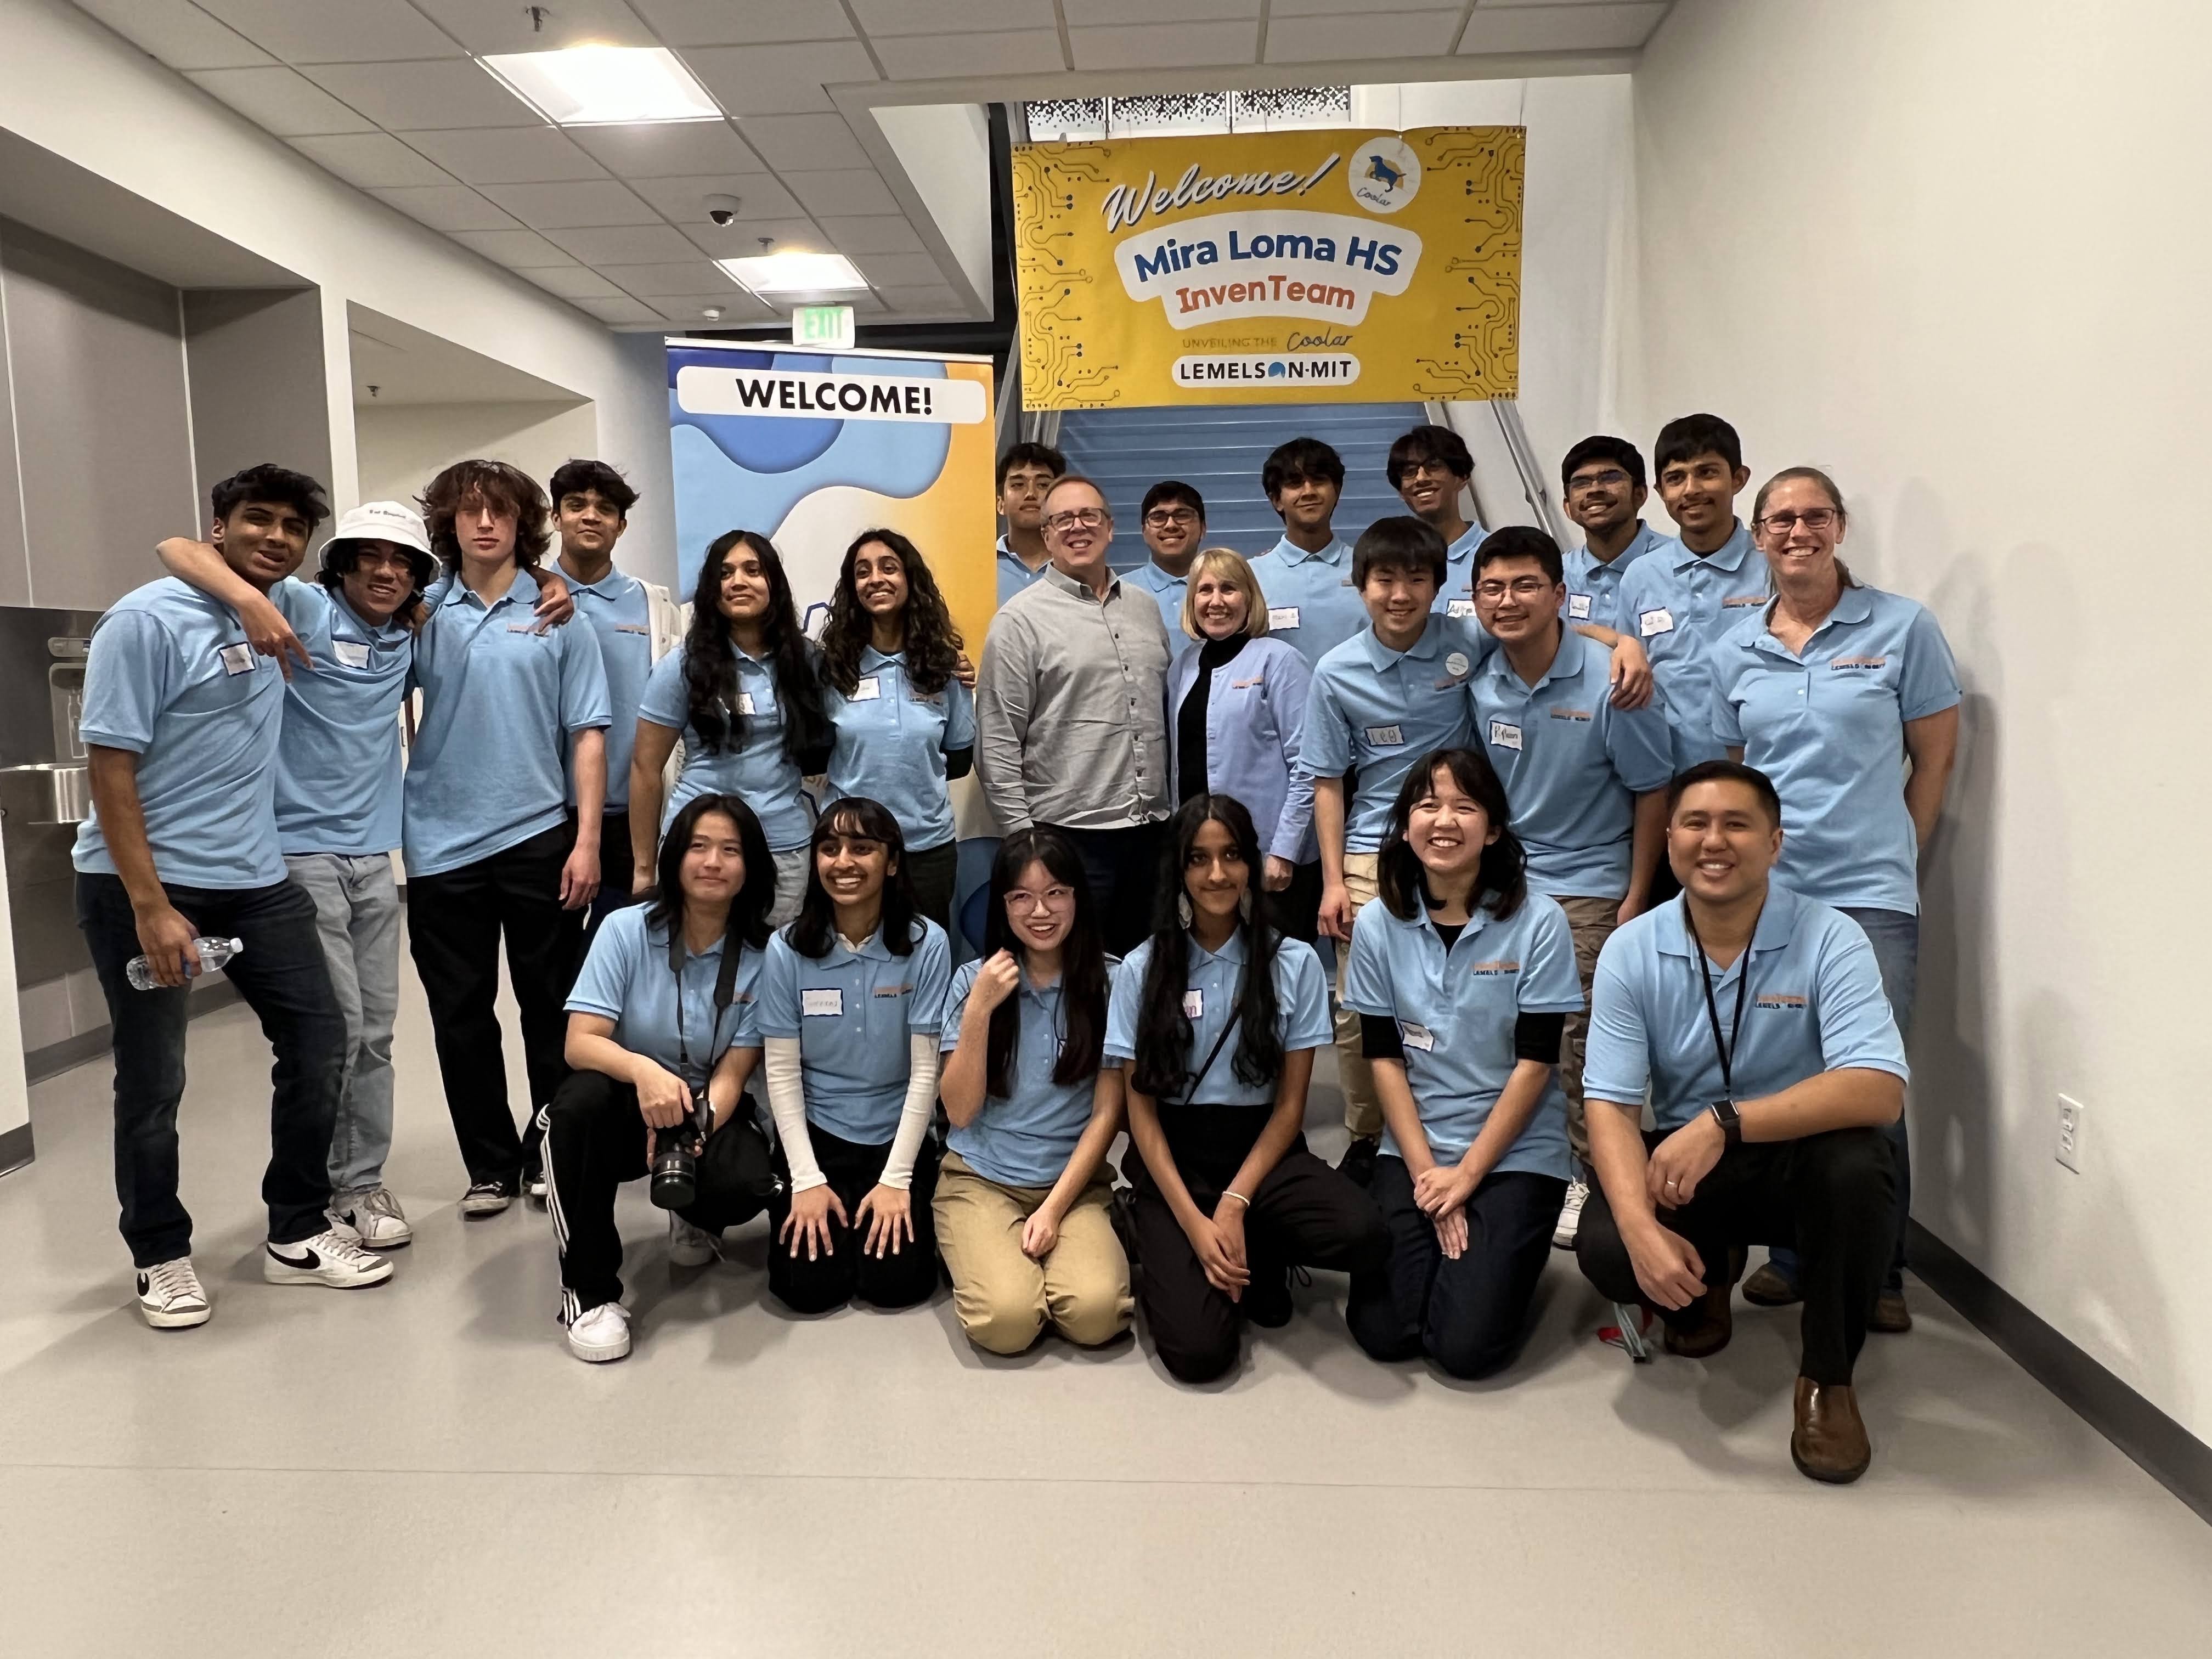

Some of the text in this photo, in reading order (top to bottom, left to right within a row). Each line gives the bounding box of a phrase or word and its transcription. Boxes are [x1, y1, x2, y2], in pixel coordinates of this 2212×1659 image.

[1101, 153, 1340, 233] Welcome!
[1134, 230, 1402, 282] Mira Loma HS
[1176, 275, 1356, 313] InvenTeam
[804, 307, 843, 339] EXIT
[1182, 327, 1353, 351] UNVEILING THE Coolar
[735, 379, 932, 415] WELCOME!
